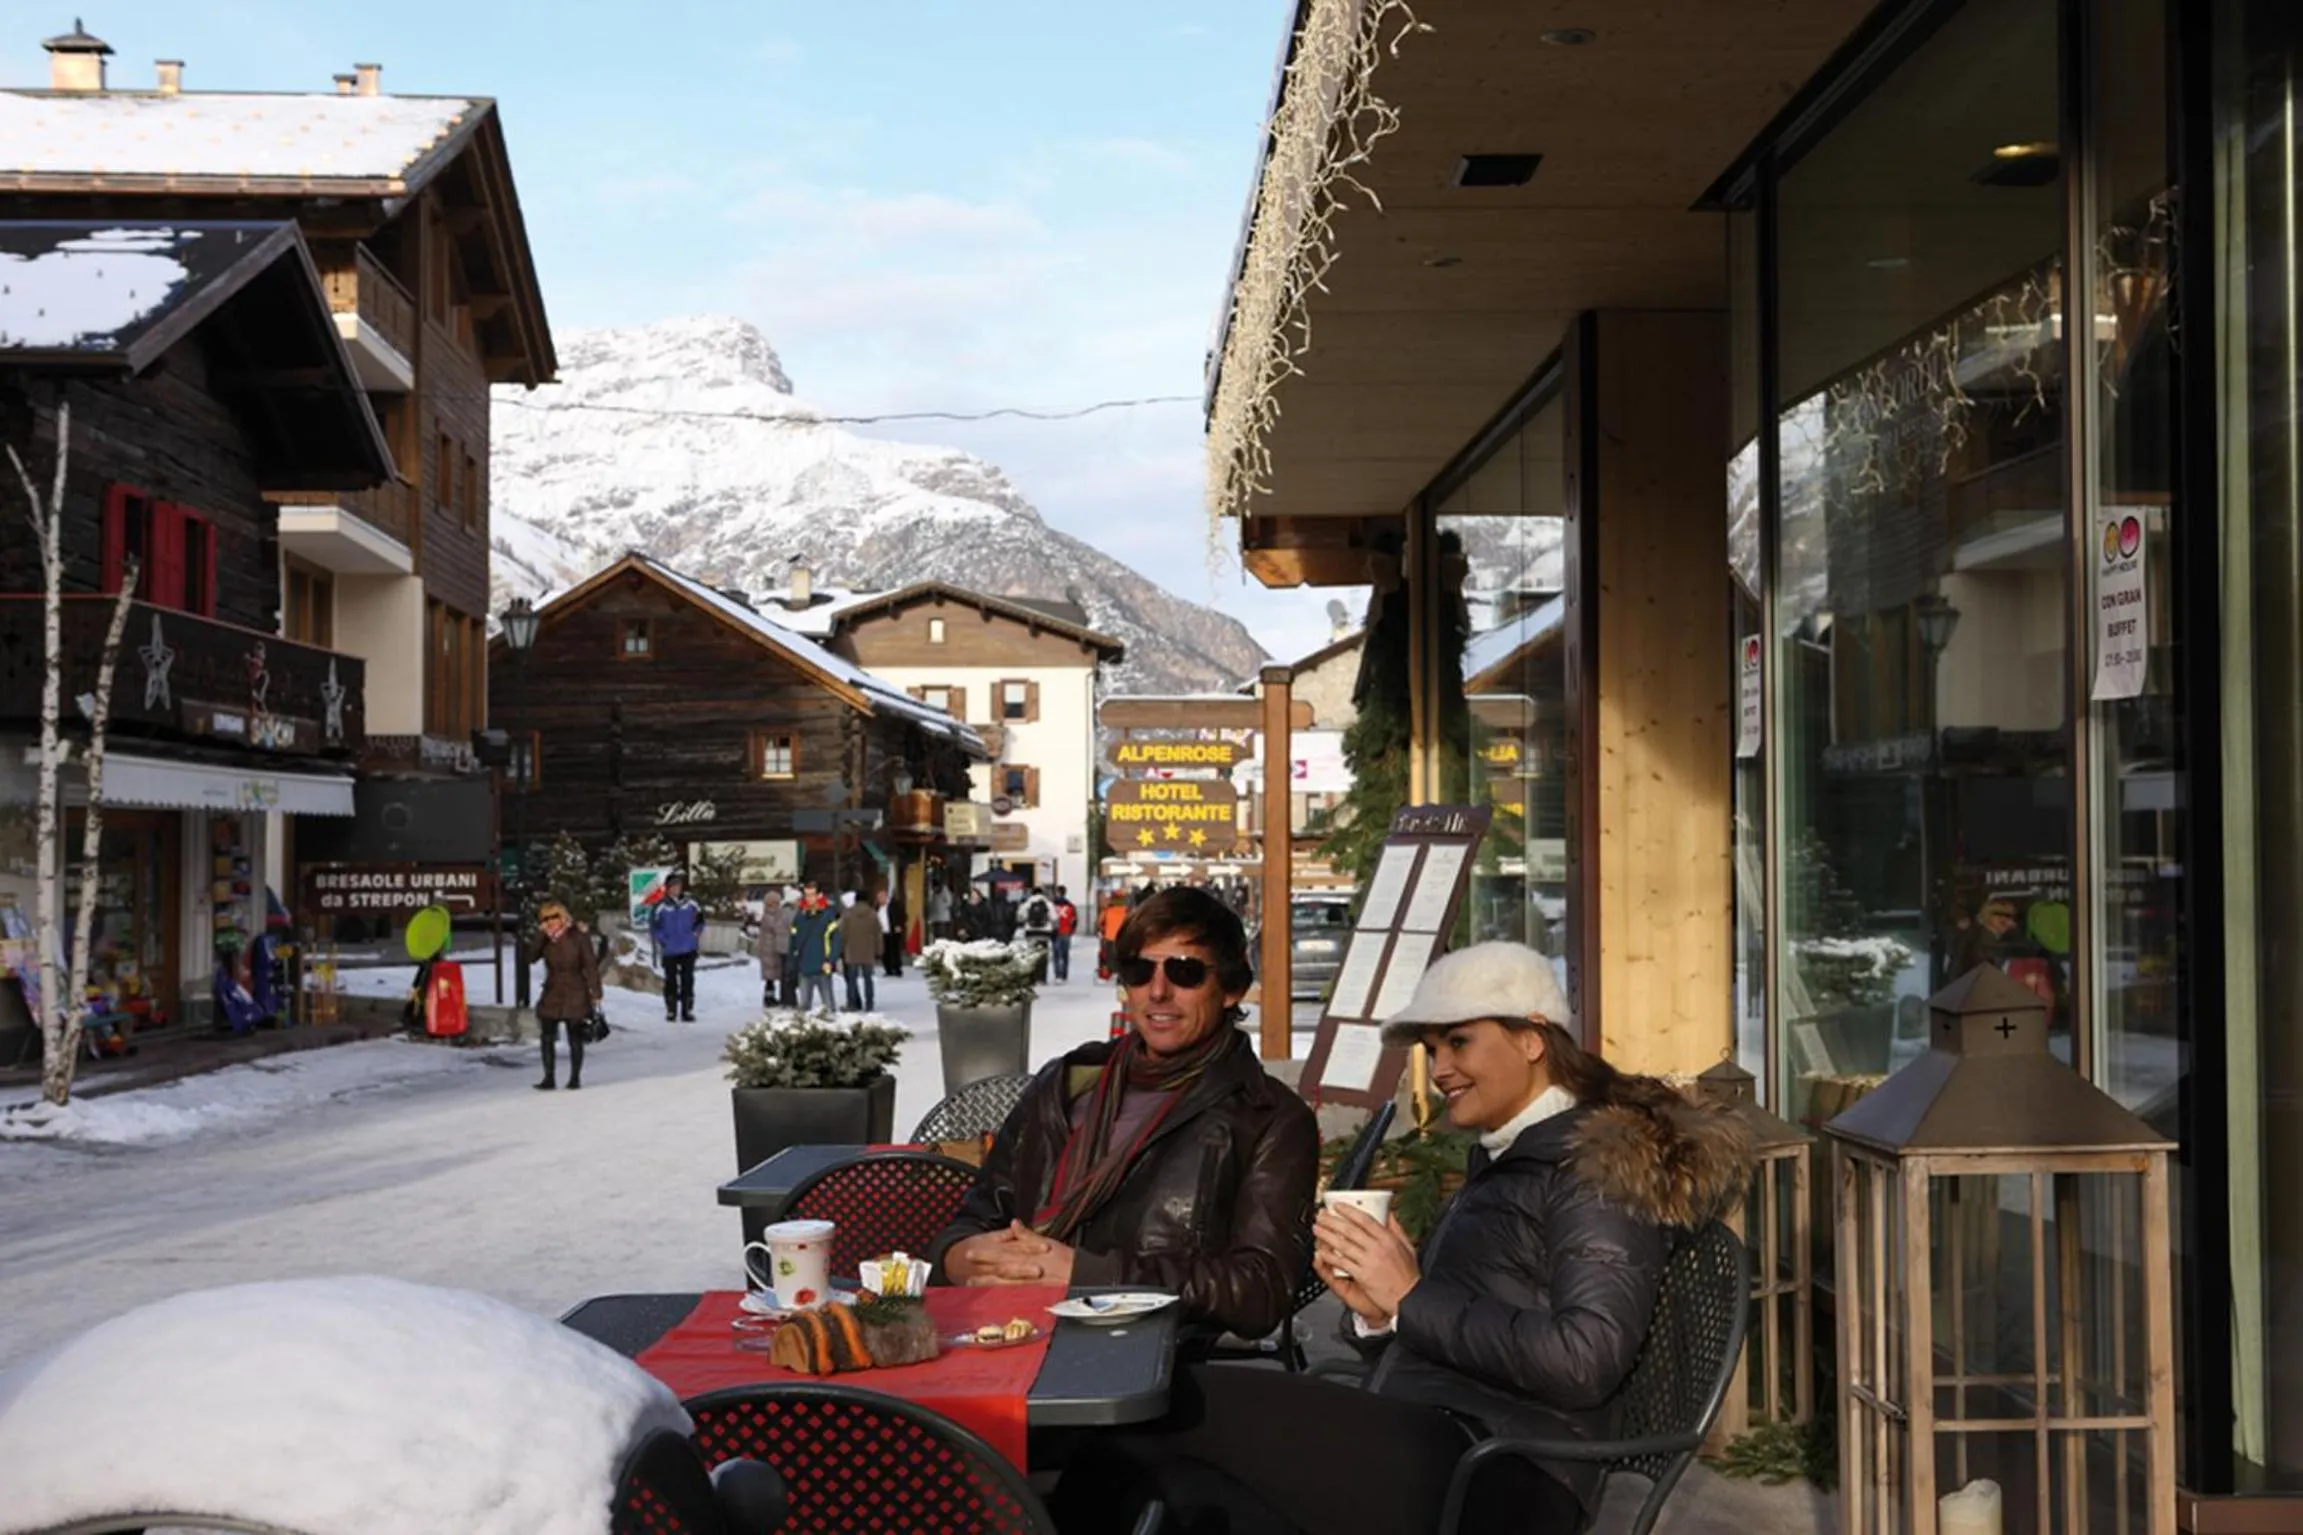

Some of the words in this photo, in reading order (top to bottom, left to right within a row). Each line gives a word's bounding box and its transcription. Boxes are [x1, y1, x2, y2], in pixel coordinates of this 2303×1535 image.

[2107, 619, 2137, 638] BUFFET
[1117, 744, 1233, 762] ALPENROSE
[1140, 783, 1204, 801] HOTEL
[1111, 803, 1232, 821] RISTORANTE
[315, 873, 405, 888] BRESAOLE
[410, 872, 478, 888] URBANI
[321, 892, 344, 908] da
[348, 891, 430, 908] STREPON
